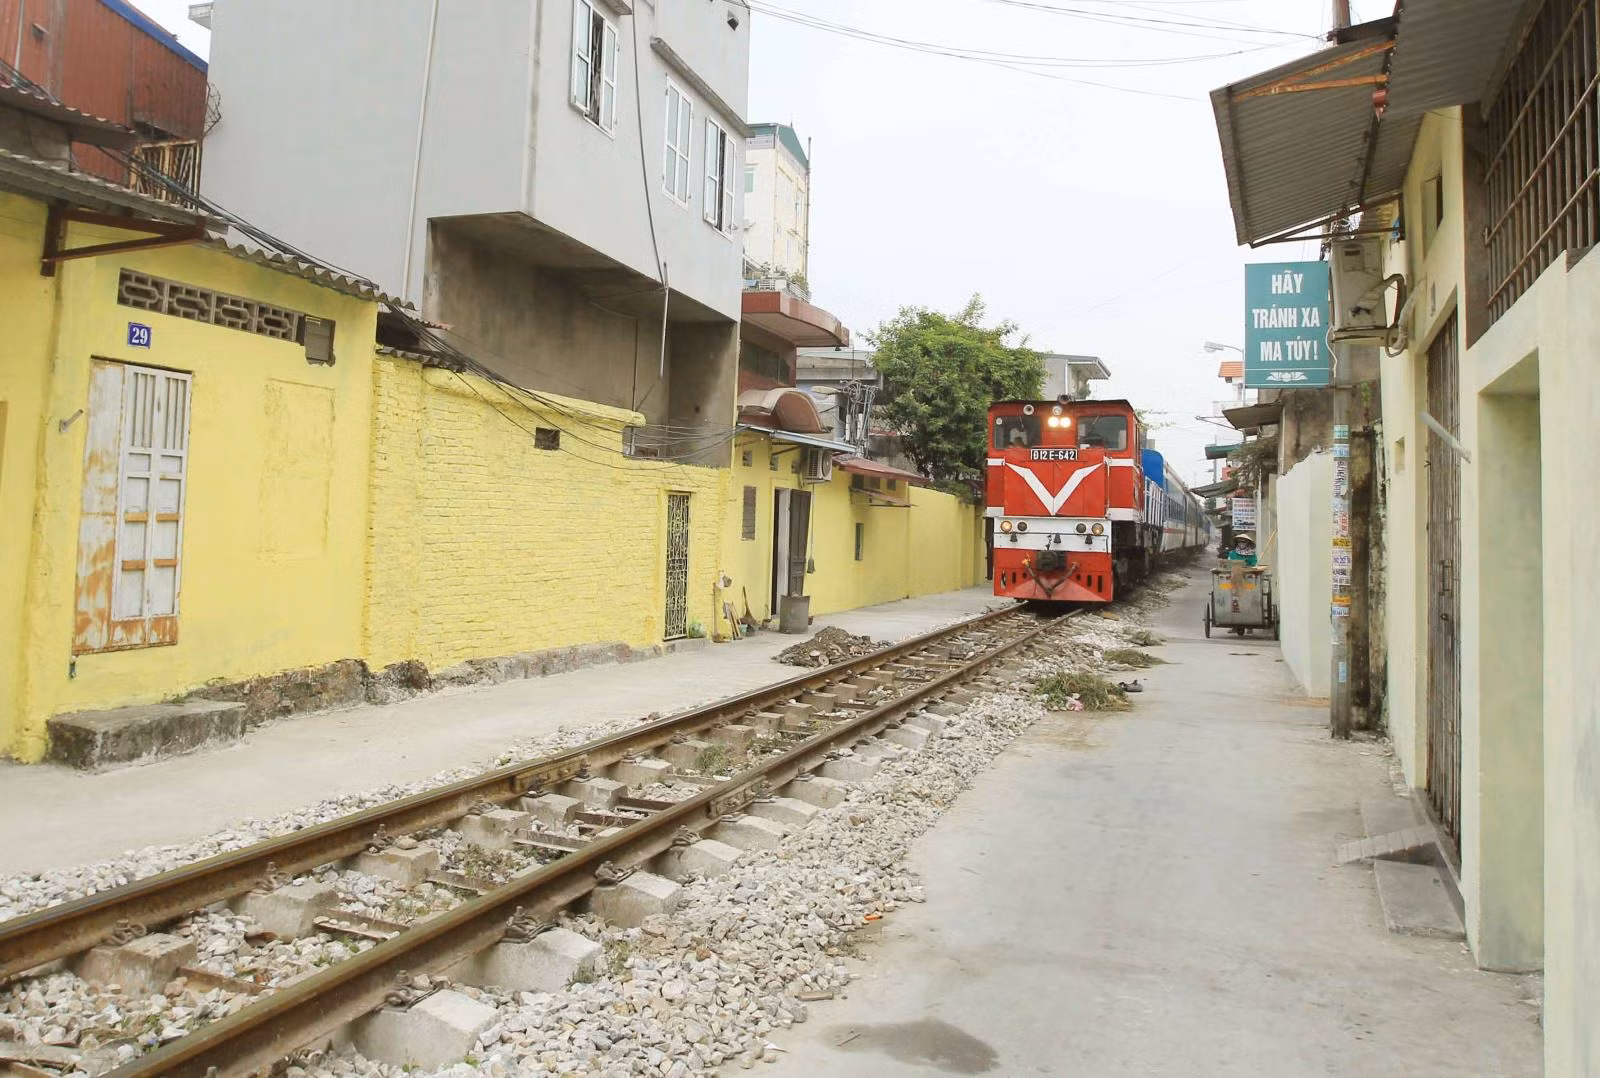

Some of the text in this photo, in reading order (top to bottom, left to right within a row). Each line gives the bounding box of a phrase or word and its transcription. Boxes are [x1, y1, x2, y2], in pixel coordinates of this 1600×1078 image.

[1271, 270, 1303, 294] HÃY
[1252, 304, 1320, 328] TRÁNH XA
[131, 326, 148, 344] 29
[1260, 341, 1282, 361] MA
